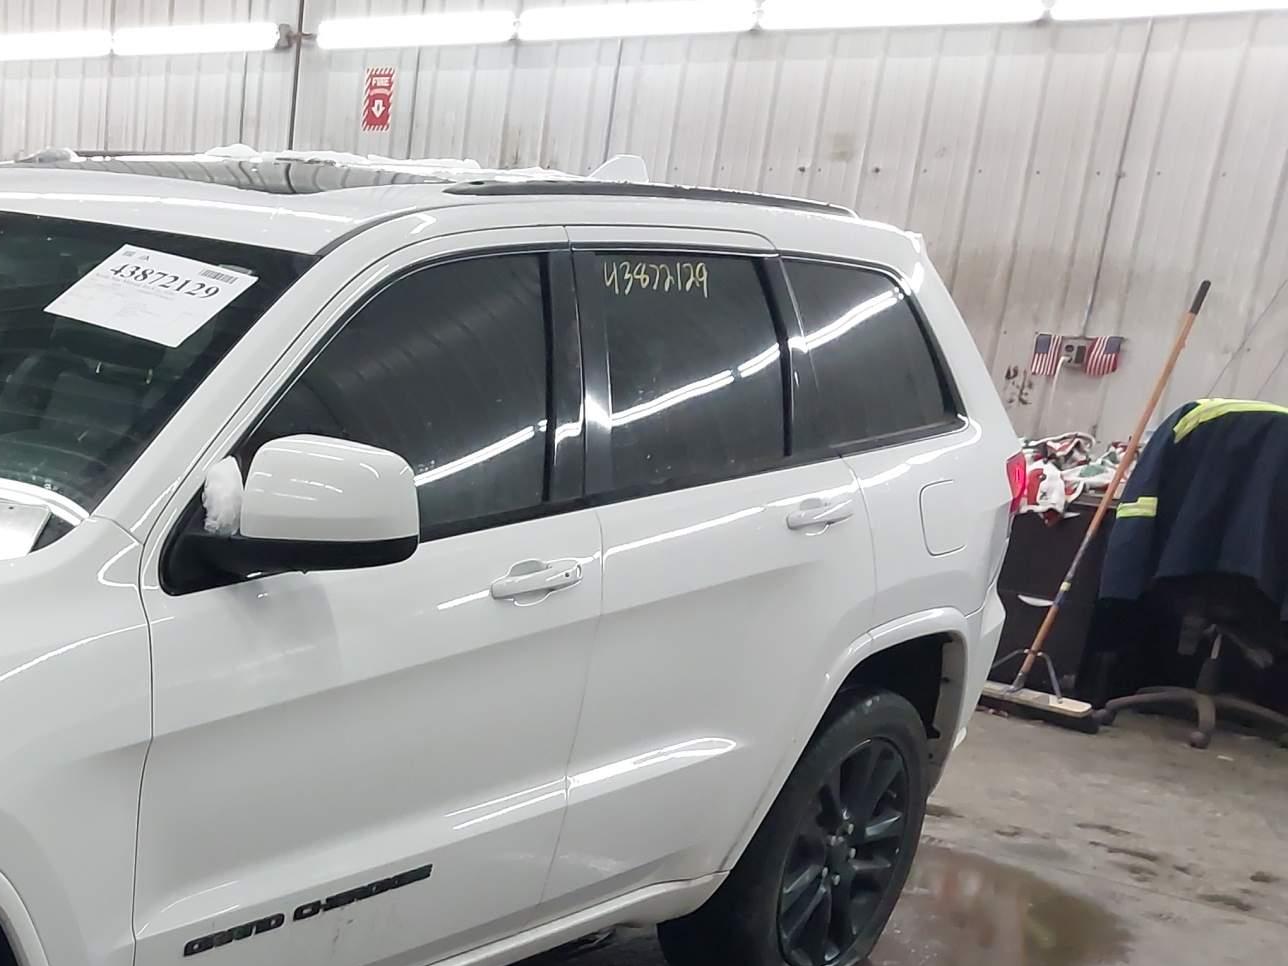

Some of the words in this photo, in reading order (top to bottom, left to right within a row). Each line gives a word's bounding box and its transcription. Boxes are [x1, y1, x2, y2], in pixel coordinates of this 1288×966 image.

[110, 263, 220, 299] 43872129
[603, 261, 709, 299] 43872129
[293, 863, 433, 921] CHOE
